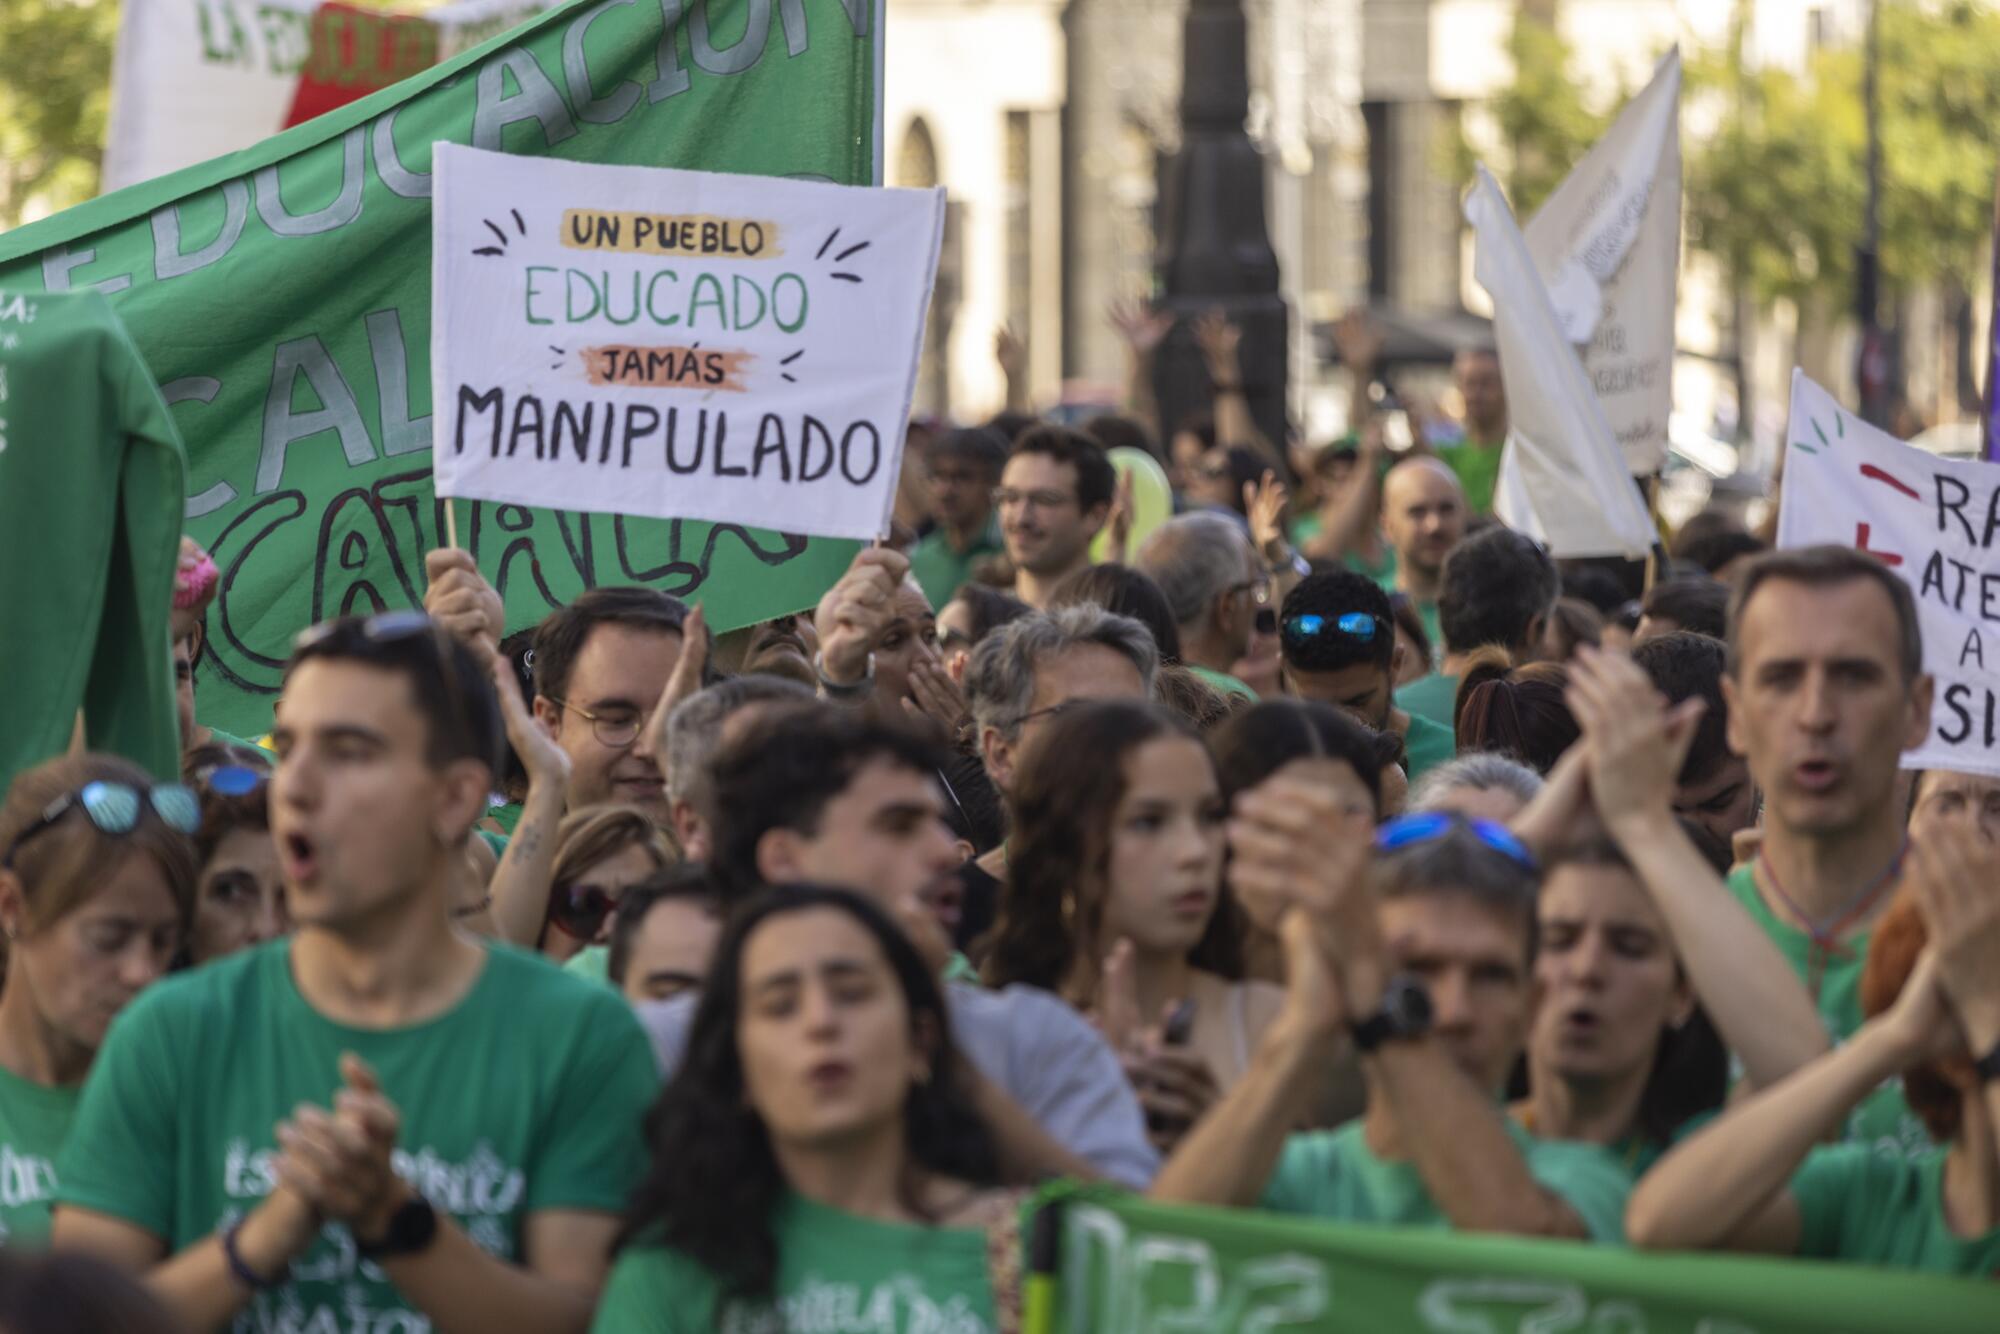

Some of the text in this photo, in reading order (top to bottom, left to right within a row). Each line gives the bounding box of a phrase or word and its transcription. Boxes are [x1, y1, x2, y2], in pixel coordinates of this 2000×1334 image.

[571, 214, 766, 257] UN PUEBLO
[524, 266, 809, 333] EDUCADO
[601, 341, 726, 384] JAMÁS
[455, 384, 881, 486] MANIPULADO
[1959, 627, 1984, 671] A
